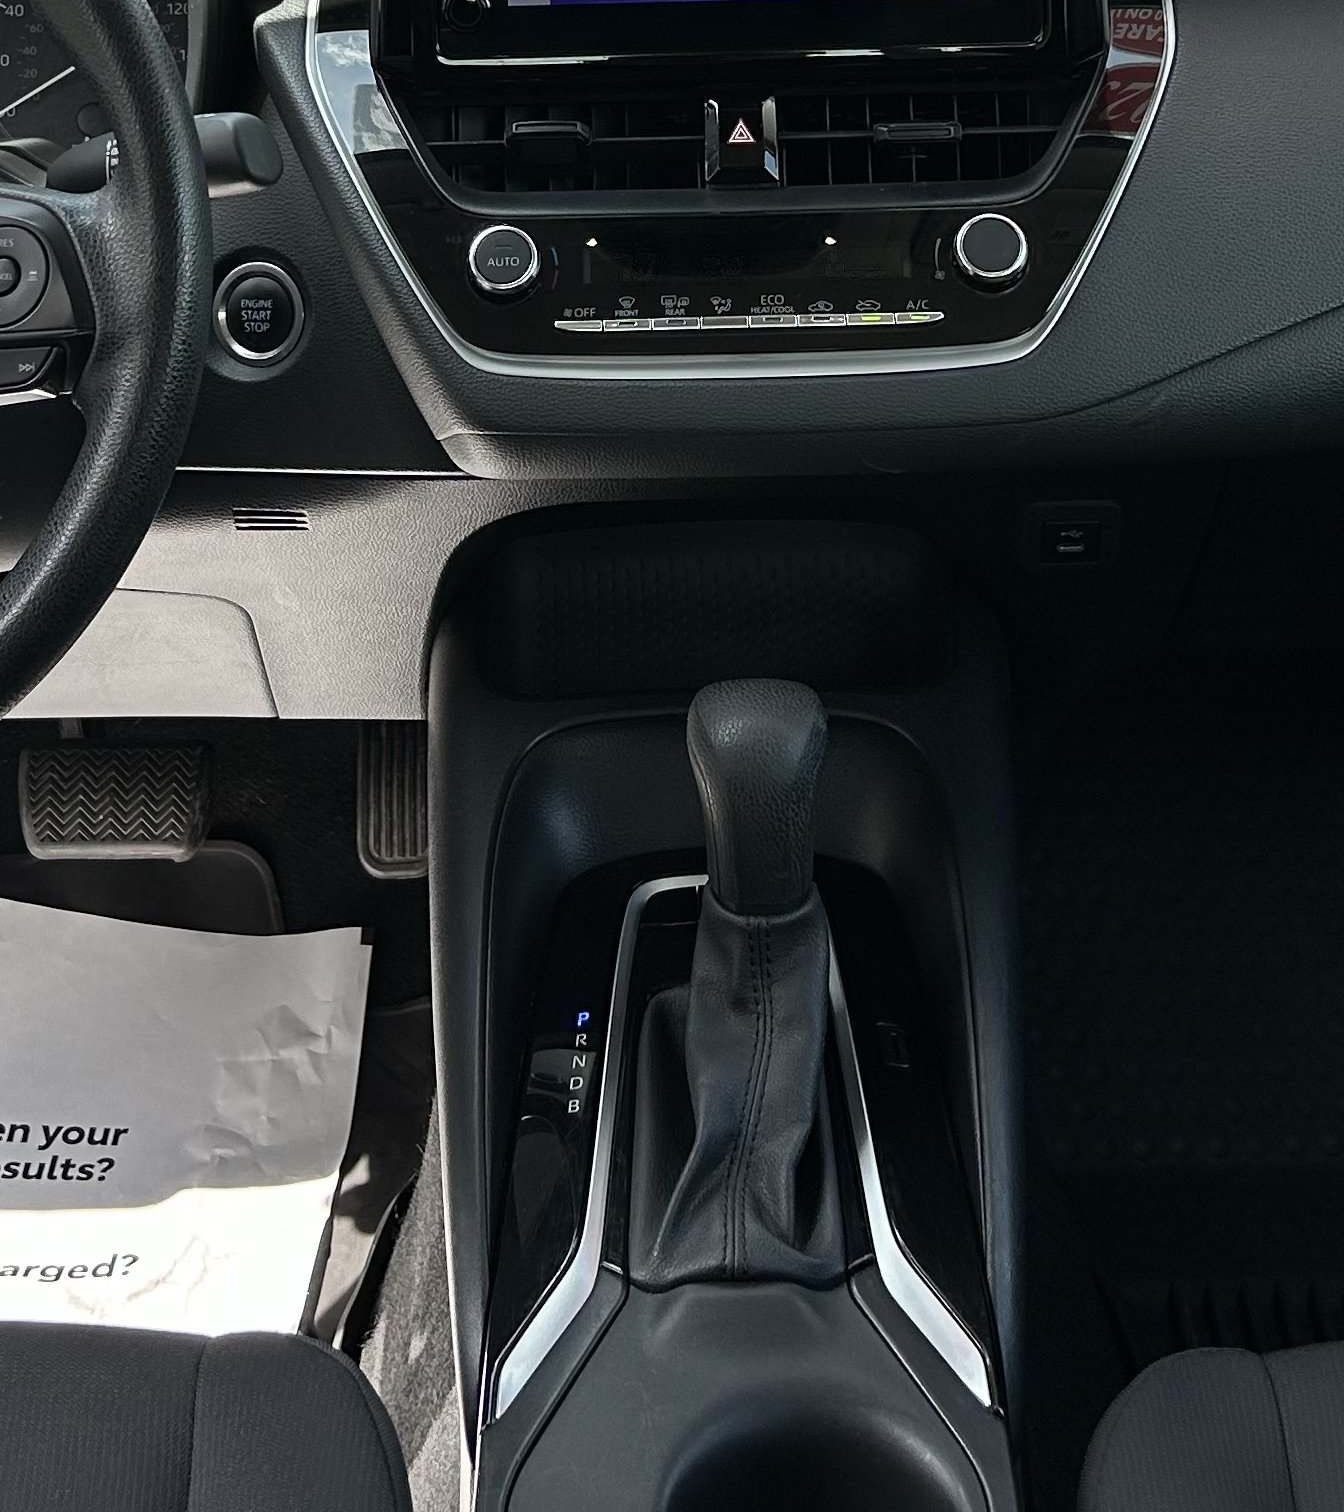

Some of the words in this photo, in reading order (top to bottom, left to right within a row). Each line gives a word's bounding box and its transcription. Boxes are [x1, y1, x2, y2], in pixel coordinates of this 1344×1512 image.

[5, 4, 25, 17] 40
[29, 23, 45, 33] 60
[22, 46, 37, 56] 40
[23, 68, 38, 78] 20
[487, 256, 520, 267] AUTO
[240, 299, 273, 309] ENGINE
[760, 294, 785, 306] ECO
[906, 299, 929, 311] A/C
[241, 310, 272, 321] START
[574, 307, 597, 318] OFF
[614, 309, 639, 317] FRONT
[664, 308, 685, 316] REAR
[750, 306, 796, 314] HEAT/COOL
[244, 322, 271, 333] STOP
[576, 1011, 591, 1027] P
[575, 1033, 588, 1047] R
[571, 1054, 587, 1069] N
[568, 1076, 584, 1091] D
[567, 1099, 580, 1114] B
[40, 1119, 129, 1150] your
